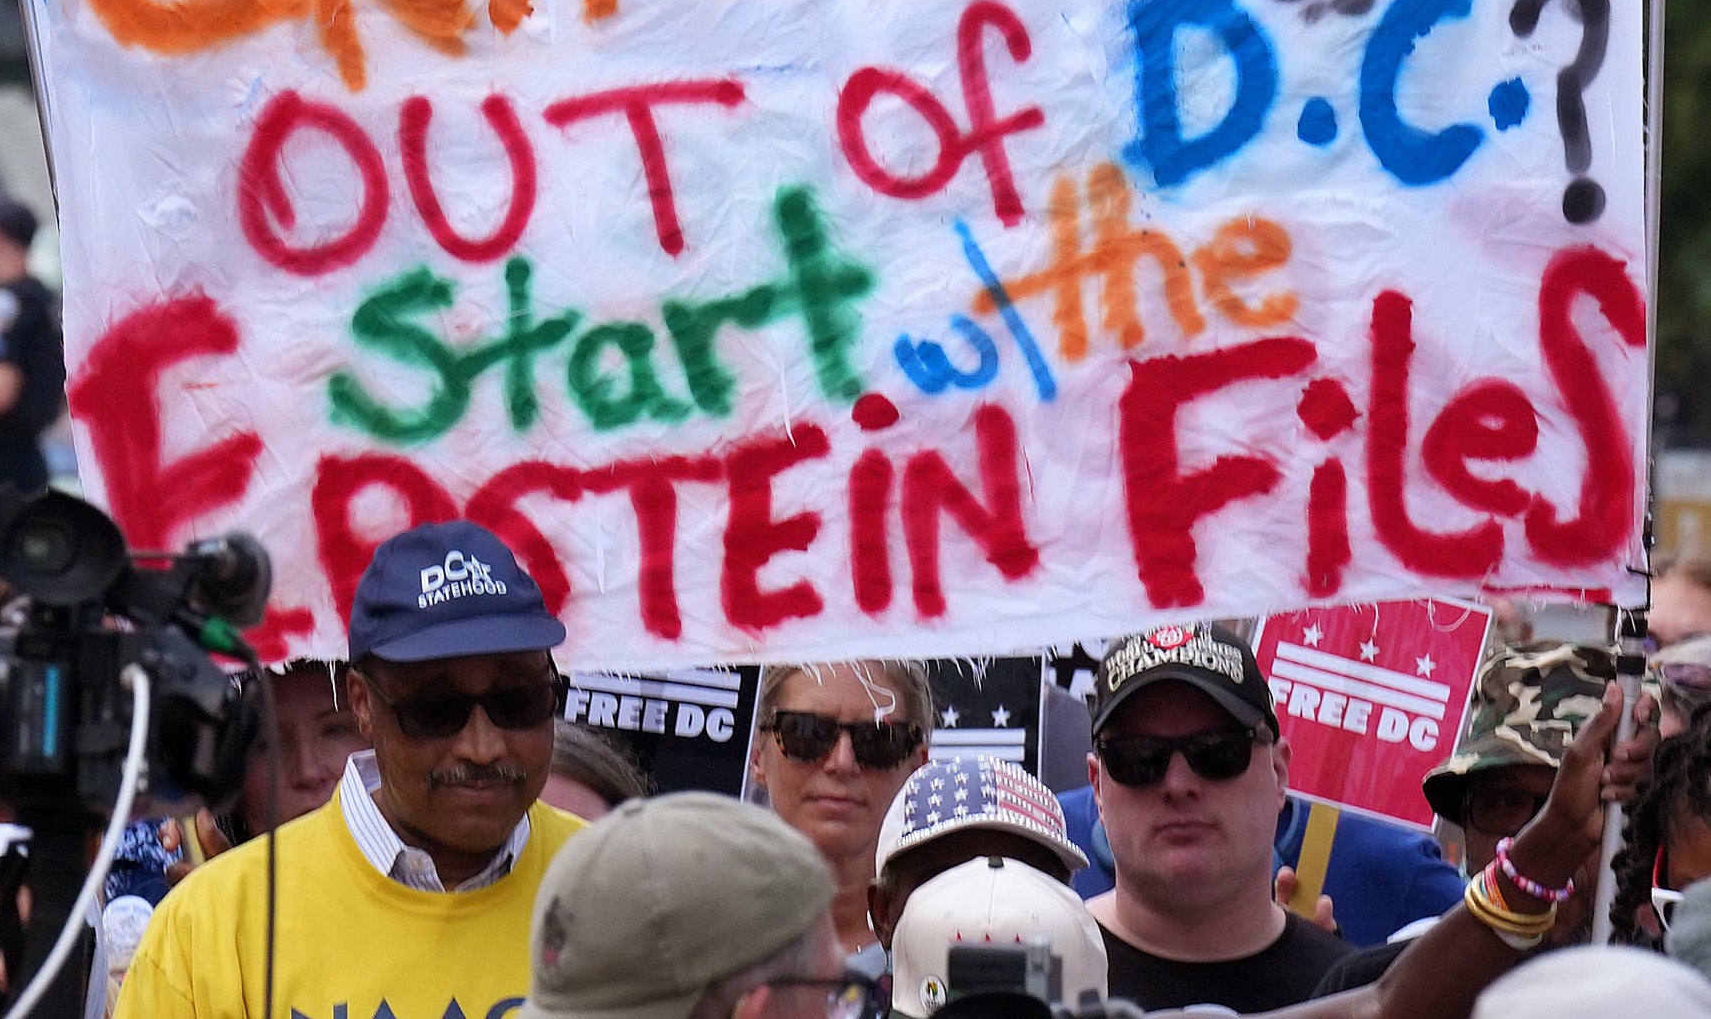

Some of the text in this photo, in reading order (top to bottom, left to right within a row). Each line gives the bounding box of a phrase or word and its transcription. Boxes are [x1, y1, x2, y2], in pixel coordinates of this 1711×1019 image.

[236, 79, 747, 277] OUT
[418, 579, 508, 610] STATEHOOD
[420, 549, 469, 594] DC
[1107, 647, 1245, 692] CHAMPIONS
[564, 687, 736, 744] FREE DC
[1267, 675, 1440, 753] FREE DC
